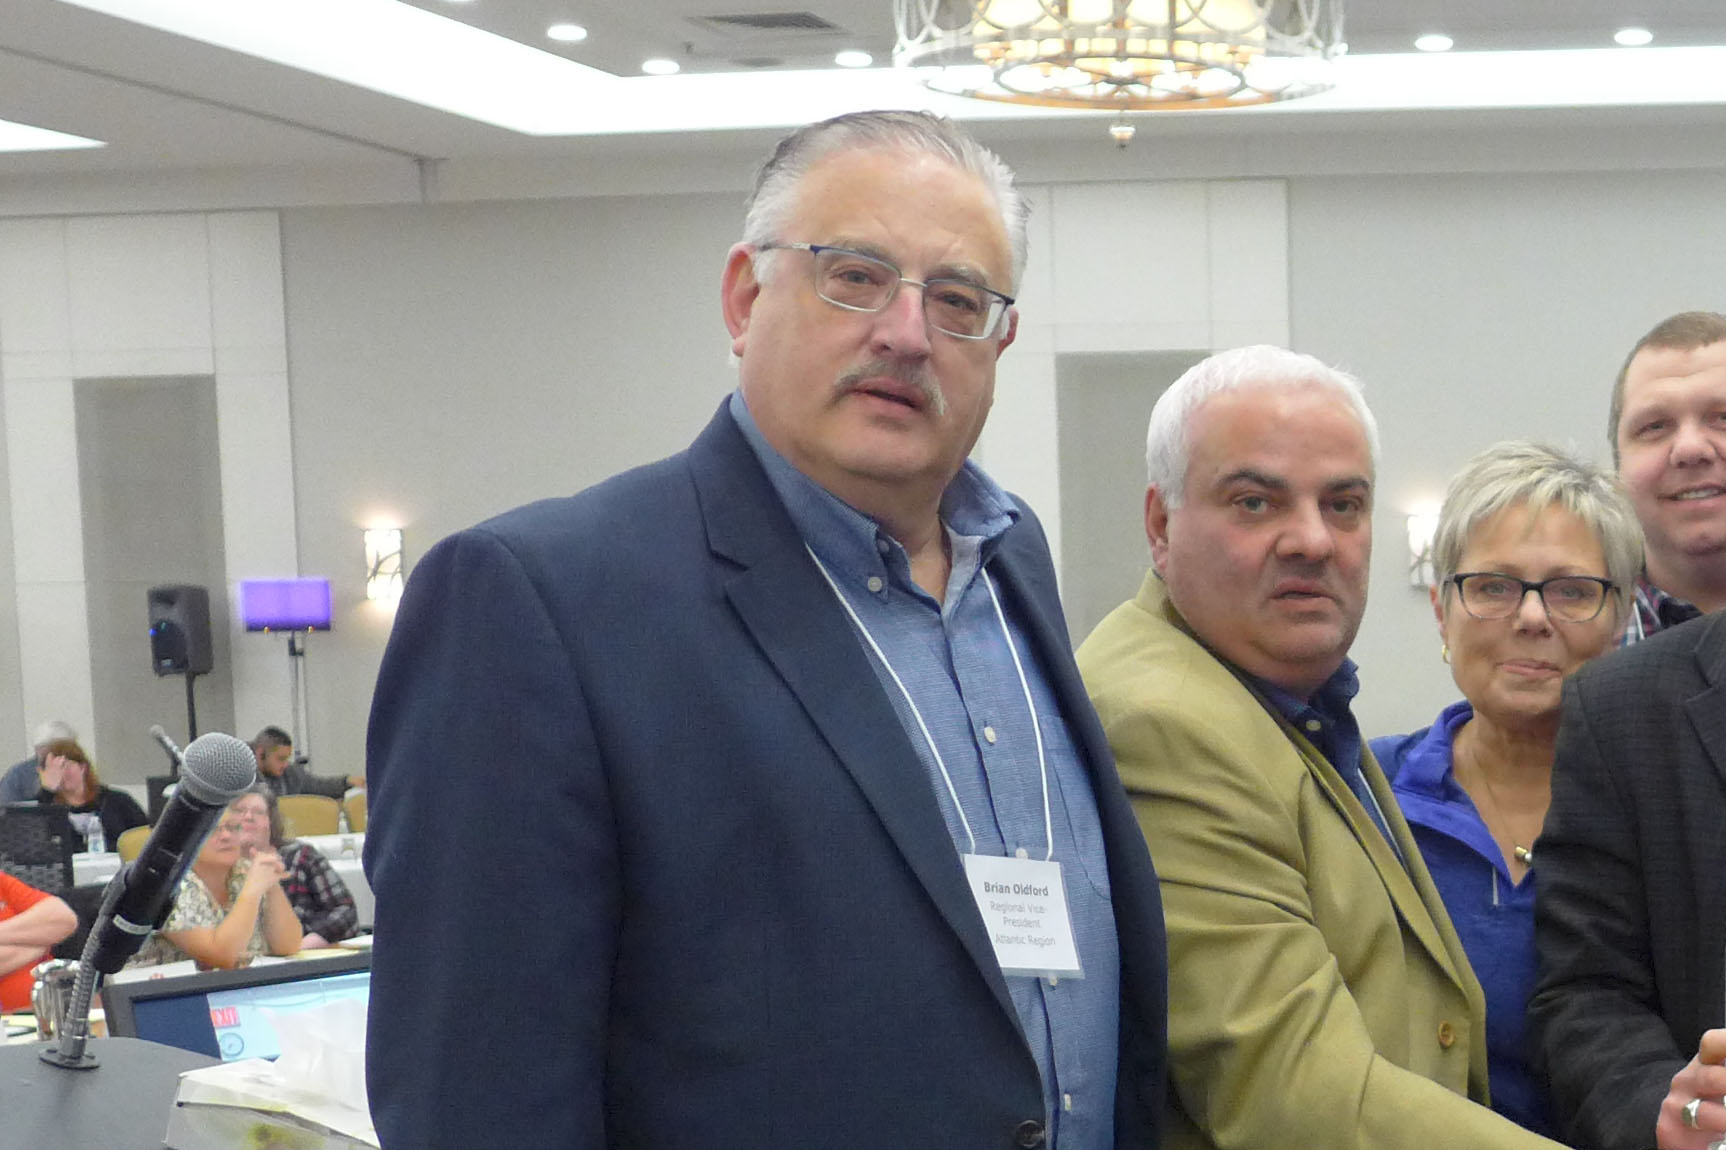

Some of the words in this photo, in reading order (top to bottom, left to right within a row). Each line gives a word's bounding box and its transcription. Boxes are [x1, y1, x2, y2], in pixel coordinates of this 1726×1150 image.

[984, 881, 1011, 894] Brian
[1013, 883, 1049, 896] Oldford
[990, 901, 1025, 915] Regional
[1003, 916, 1041, 929] President
[995, 934, 1026, 945] Atlantic
[1028, 935, 1056, 948] Region
